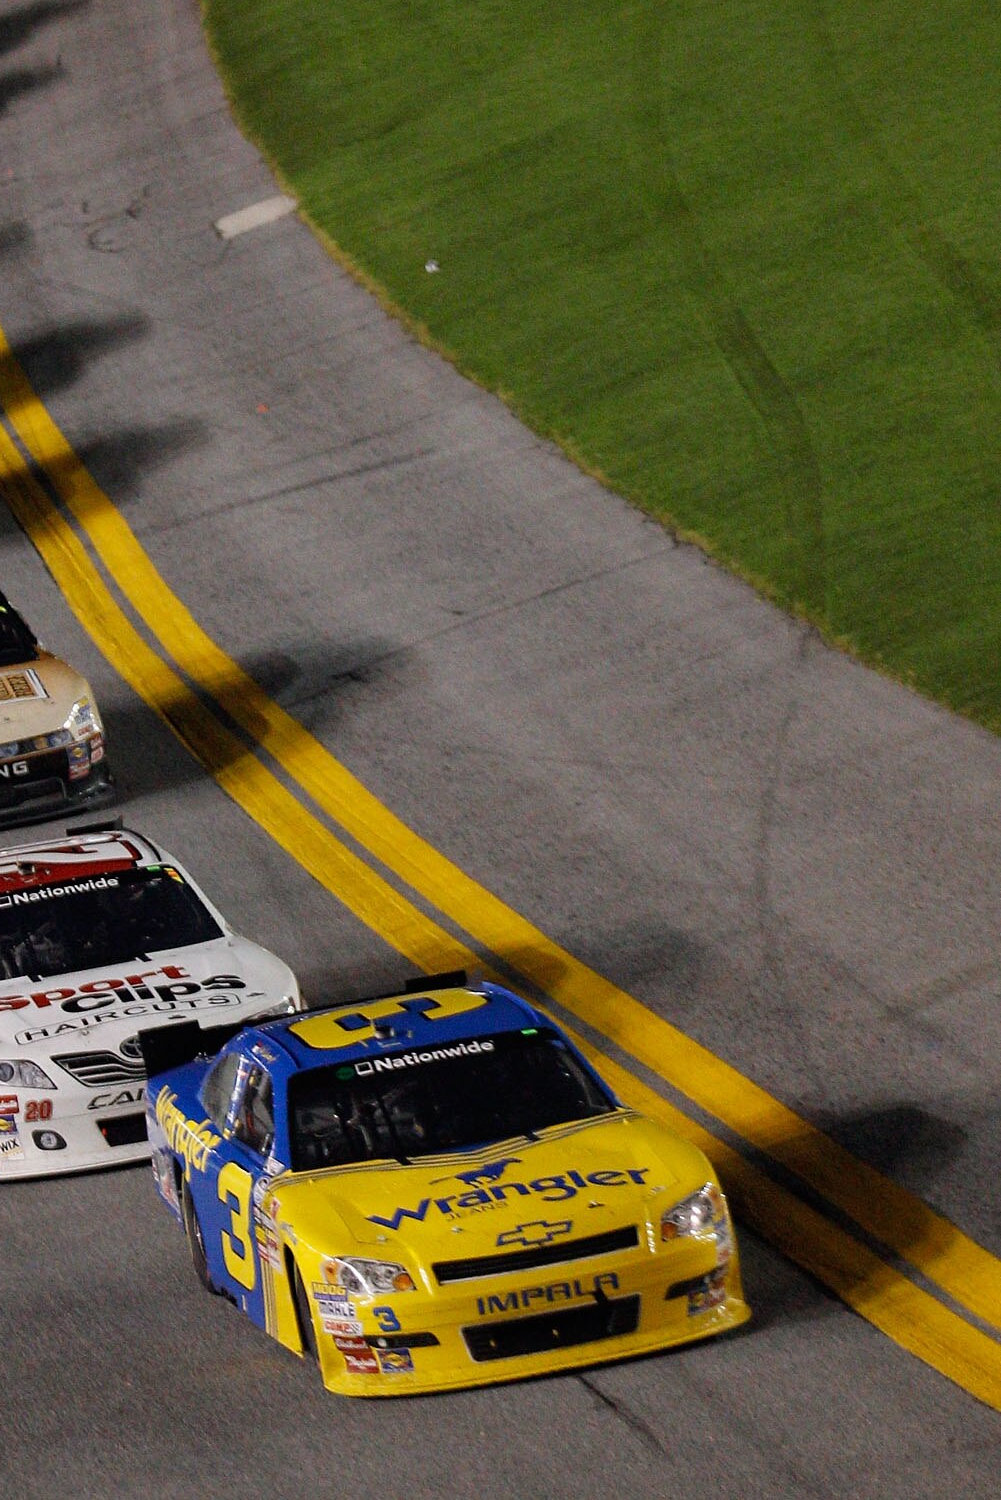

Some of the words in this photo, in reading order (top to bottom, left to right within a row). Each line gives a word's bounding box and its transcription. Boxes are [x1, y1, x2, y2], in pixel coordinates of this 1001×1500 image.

[13, 877, 119, 905] Nationwide
[24, 994, 231, 1041] HAIRCUTS
[374, 1041, 494, 1073] Nationwide
[24, 1099, 53, 1123] 20
[216, 1161, 255, 1291] 3
[319, 1301, 355, 1316] MAHLE
[477, 1271, 620, 1316] IMPALA
[373, 1306, 401, 1332] 3
